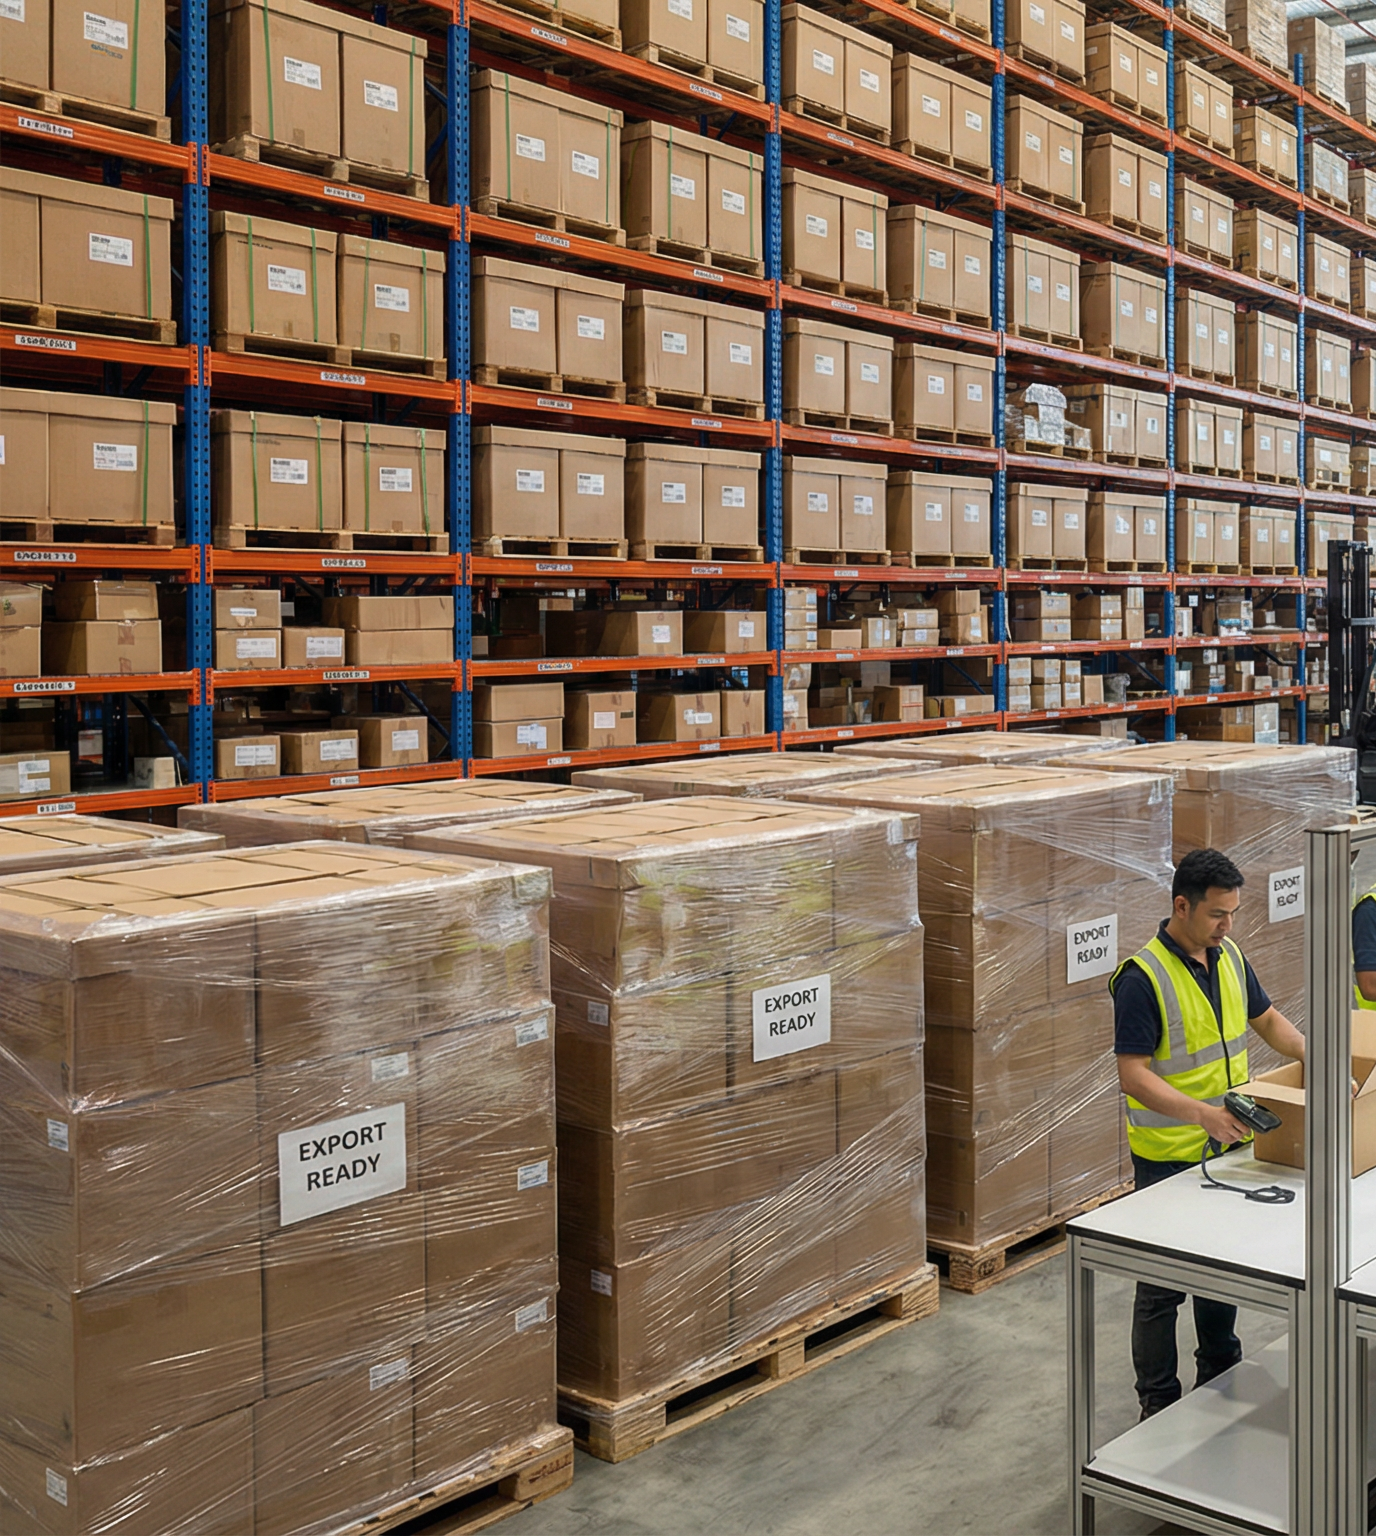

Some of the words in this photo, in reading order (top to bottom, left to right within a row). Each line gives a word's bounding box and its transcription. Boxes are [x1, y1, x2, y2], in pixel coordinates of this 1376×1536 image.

[765, 987, 819, 1013] EXPORT
[769, 1011, 816, 1037] READY
[299, 1122, 387, 1162] EXPORT
[307, 1153, 381, 1192] READY
